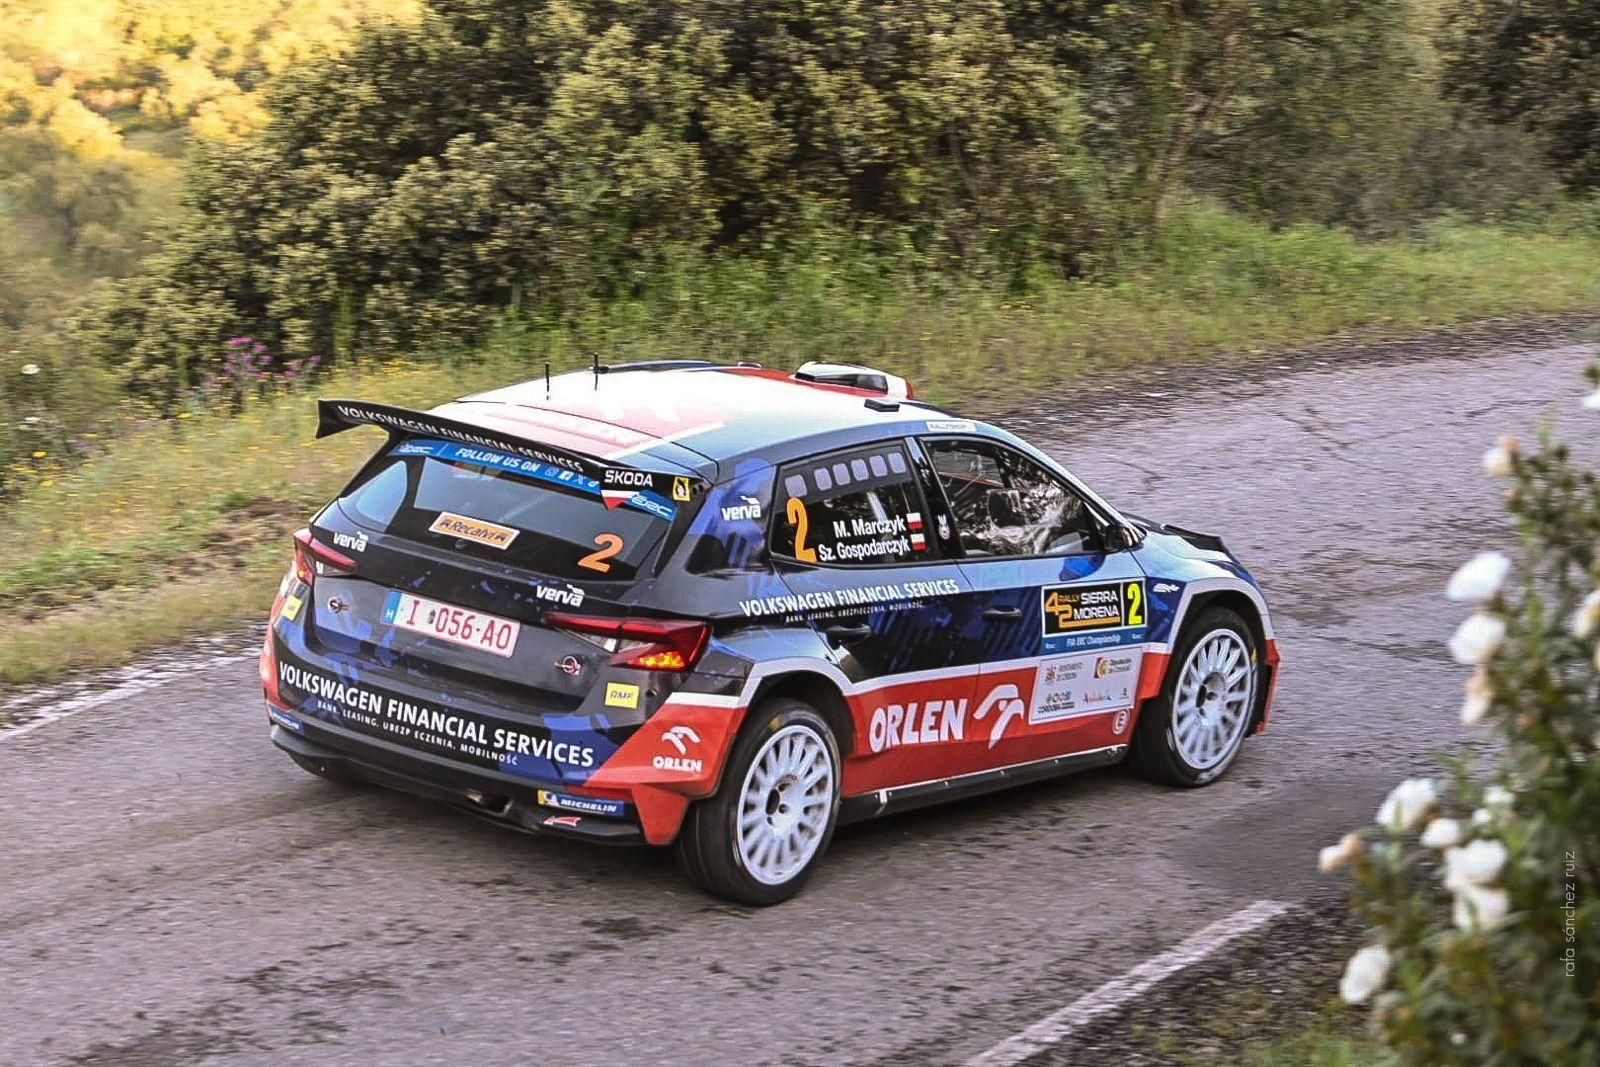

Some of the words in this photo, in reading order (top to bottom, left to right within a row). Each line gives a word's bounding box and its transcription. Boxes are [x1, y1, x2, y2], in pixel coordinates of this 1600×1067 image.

[338, 405, 438, 433] VOLKSWAGEN
[441, 428, 515, 452] FINANCIAL
[518, 447, 584, 472] SERVICES
[455, 448, 504, 464] FOLLOW
[503, 457, 521, 467] US
[521, 459, 540, 472] ON
[604, 470, 653, 487] SKODA
[721, 504, 761, 521] verva
[786, 497, 817, 562] 2
[833, 520, 851, 538] M.
[852, 515, 906, 537] Marczyk
[333, 532, 367, 552] verva
[577, 533, 624, 573] 2
[818, 544, 836, 561] Sz.
[837, 536, 911, 560] Gospodarczyk
[536, 585, 584, 607] verva
[738, 590, 836, 617] VOLKSWAGEN
[835, 584, 905, 606] FINANCIAL
[903, 579, 960, 599] SERVICES
[1081, 590, 1119, 605] SIERRA
[1127, 583, 1143, 625] 2
[1073, 605, 1120, 620] MORENA
[279, 661, 382, 715] VOLKSWAGEN
[387, 699, 488, 744] FINANCIAL
[494, 728, 594, 767] SERVICES
[868, 698, 968, 753] ORLEN
[652, 756, 703, 772] ORLEN
[560, 799, 617, 812] MICHELIN
